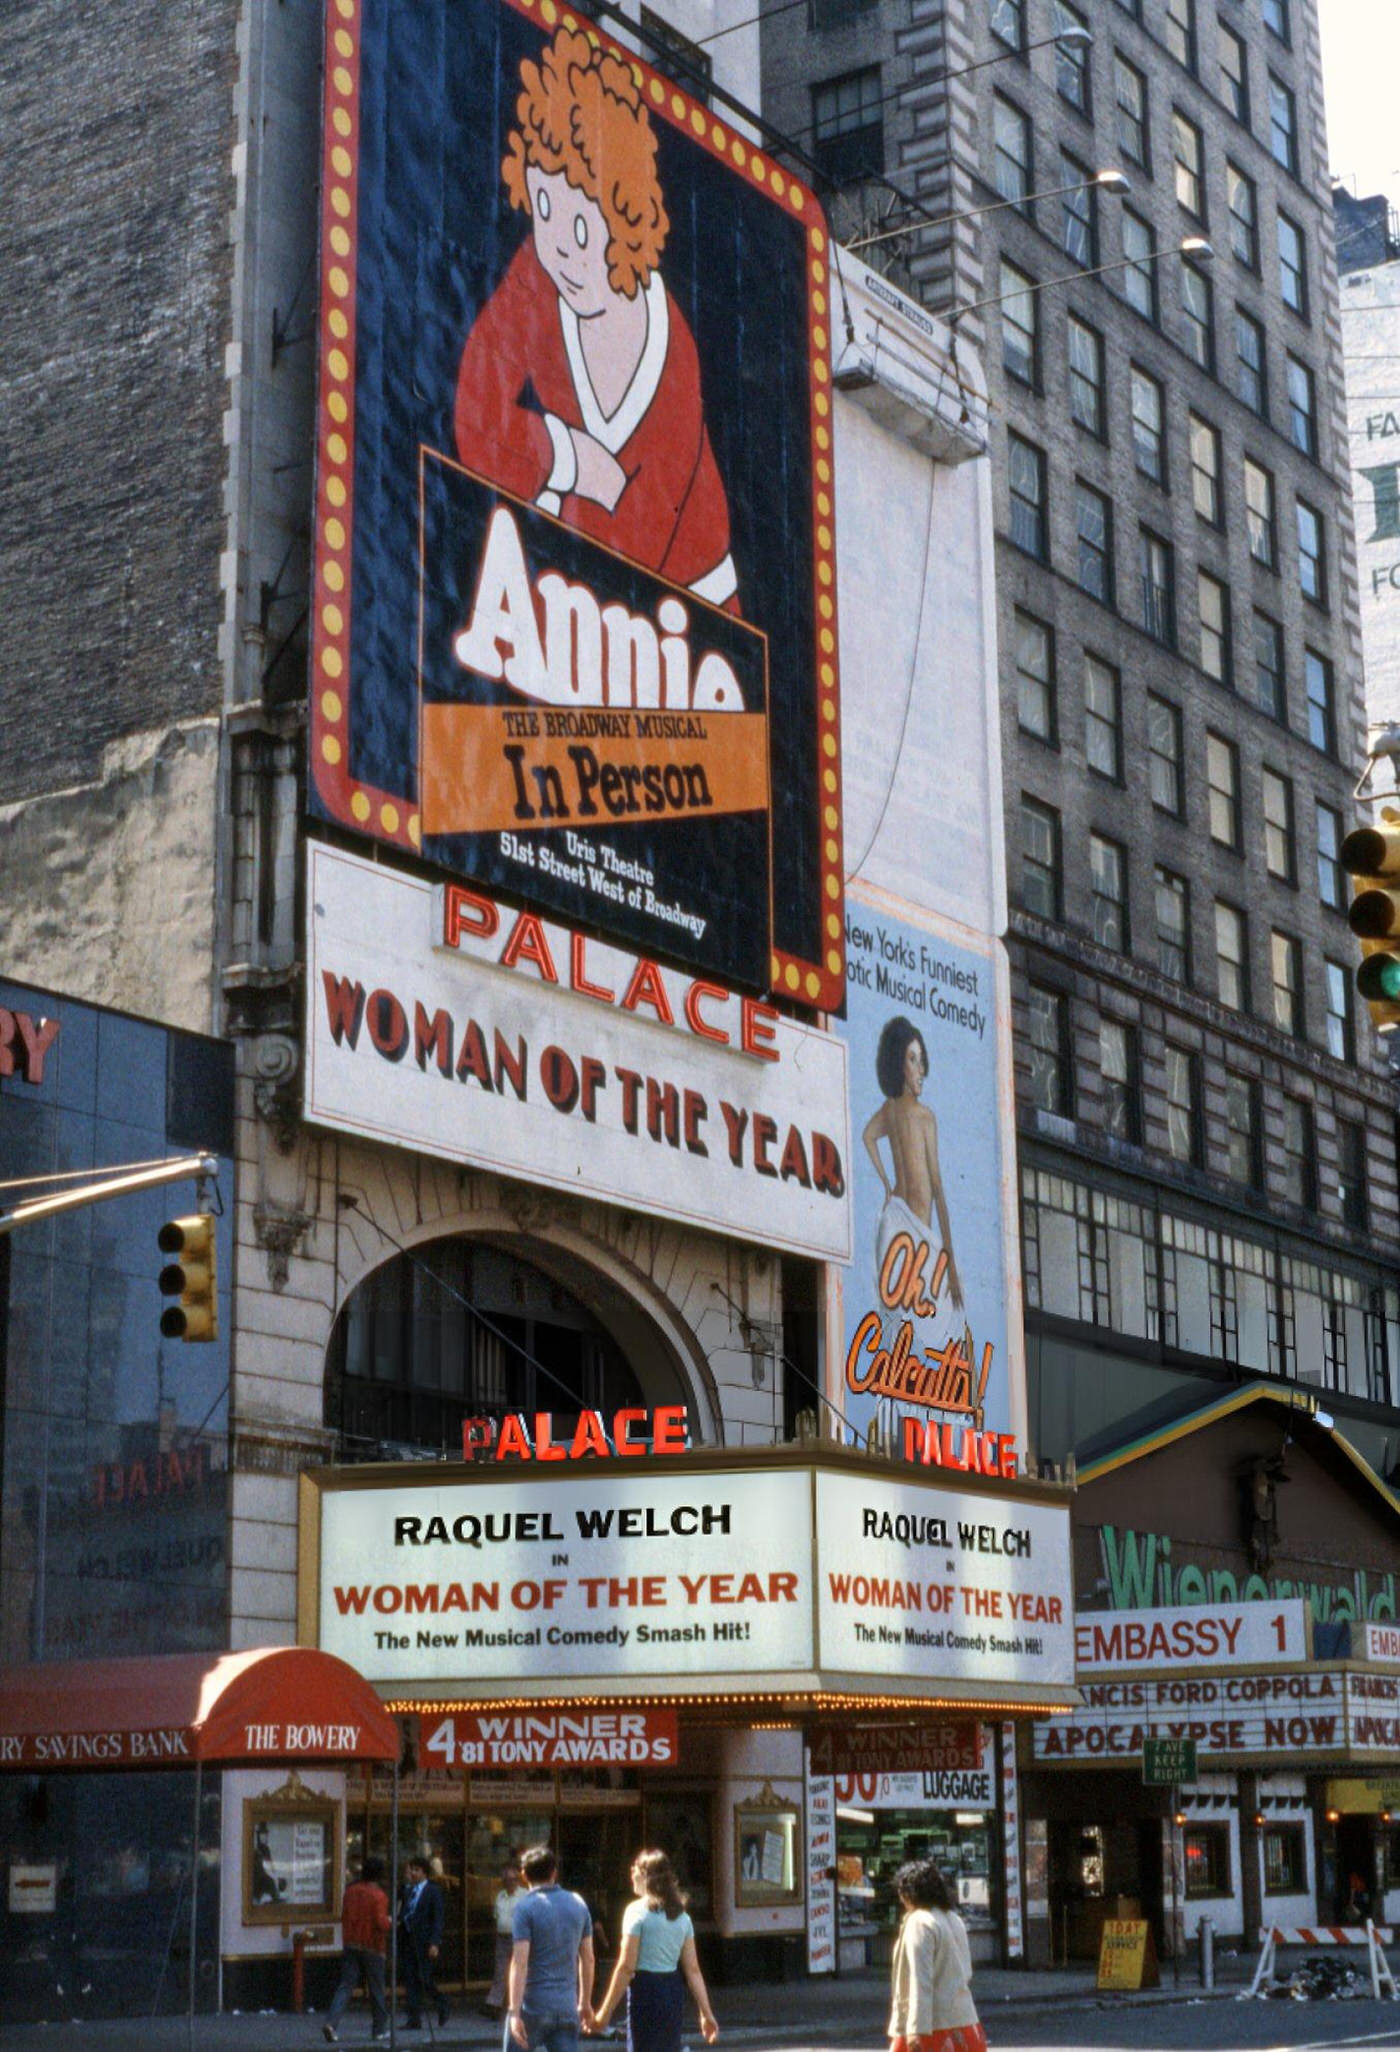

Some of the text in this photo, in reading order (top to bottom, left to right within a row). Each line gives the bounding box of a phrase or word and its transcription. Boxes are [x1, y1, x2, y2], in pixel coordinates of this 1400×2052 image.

[453, 506, 747, 713] Annie
[503, 712, 708, 740] THE BROADWAY MUSICAL
[503, 745, 713, 820] In Person
[566, 830, 654, 887] Uris Theatre
[500, 831, 707, 940] 51st Street West of Broadway
[444, 883, 781, 1062] PALACE
[876, 926, 916, 971] York's
[920, 945, 979, 997] Funniest
[846, 956, 986, 1041] otic Musical Comedy
[321, 969, 845, 1199] WOMAN OF THE YEAR
[879, 1231, 949, 1319] Oh!
[462, 1405, 693, 1462] PALACE
[902, 1415, 1020, 1480] PALACE
[394, 1504, 732, 1549] RAQUEL WELCH
[862, 1507, 1032, 1558] RAQUEL WELCH
[551, 1553, 569, 1566] IN
[334, 1571, 799, 1616] WOMAN OF THE YEAR
[829, 1572, 1063, 1624] WOMAN OF THE YEAR
[374, 1622, 751, 1650] The New Musical Comedy Smash Hit!
[854, 1622, 1043, 1655] The New Musical Comedy Smash Hit!
[1075, 1615, 1287, 1664] EMBASSY 1
[1156, 1679, 1218, 1706] FORD
[1226, 1675, 1336, 1702] COPPOLA
[35, 1734, 122, 1760] SAVINGS
[130, 1731, 189, 1757] BANK
[245, 1725, 361, 1751] THE BOWERY
[426, 1714, 647, 1763] 4 WINNER
[458, 1738, 671, 1764] '81 TONY AWARDS
[847, 1728, 957, 1750] WINNER
[1264, 1716, 1337, 1749] NOW
[895, 1747, 974, 1768] AWARDS
[923, 1771, 990, 1800] LUGGAGE
